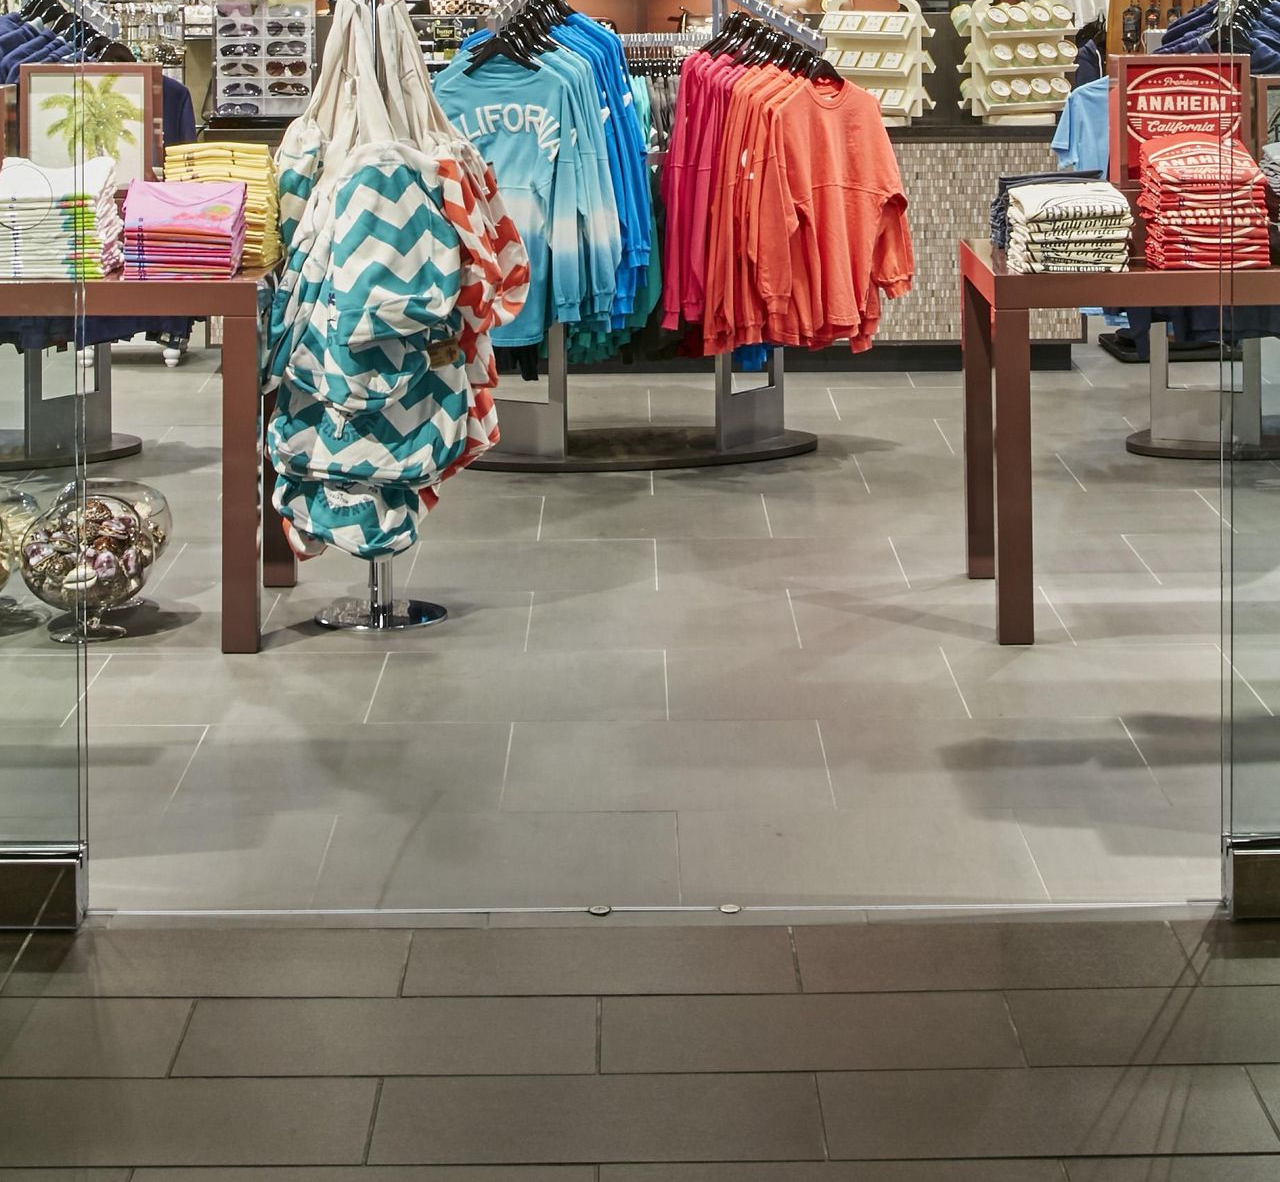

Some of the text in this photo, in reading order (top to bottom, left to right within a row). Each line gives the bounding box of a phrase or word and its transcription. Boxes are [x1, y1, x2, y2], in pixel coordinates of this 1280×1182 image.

[1164, 76, 1199, 86] Premium
[1136, 96, 1226, 111] ANAHEIM
[460, 103, 561, 163] LIFORNIA
[1147, 120, 1215, 134] California
